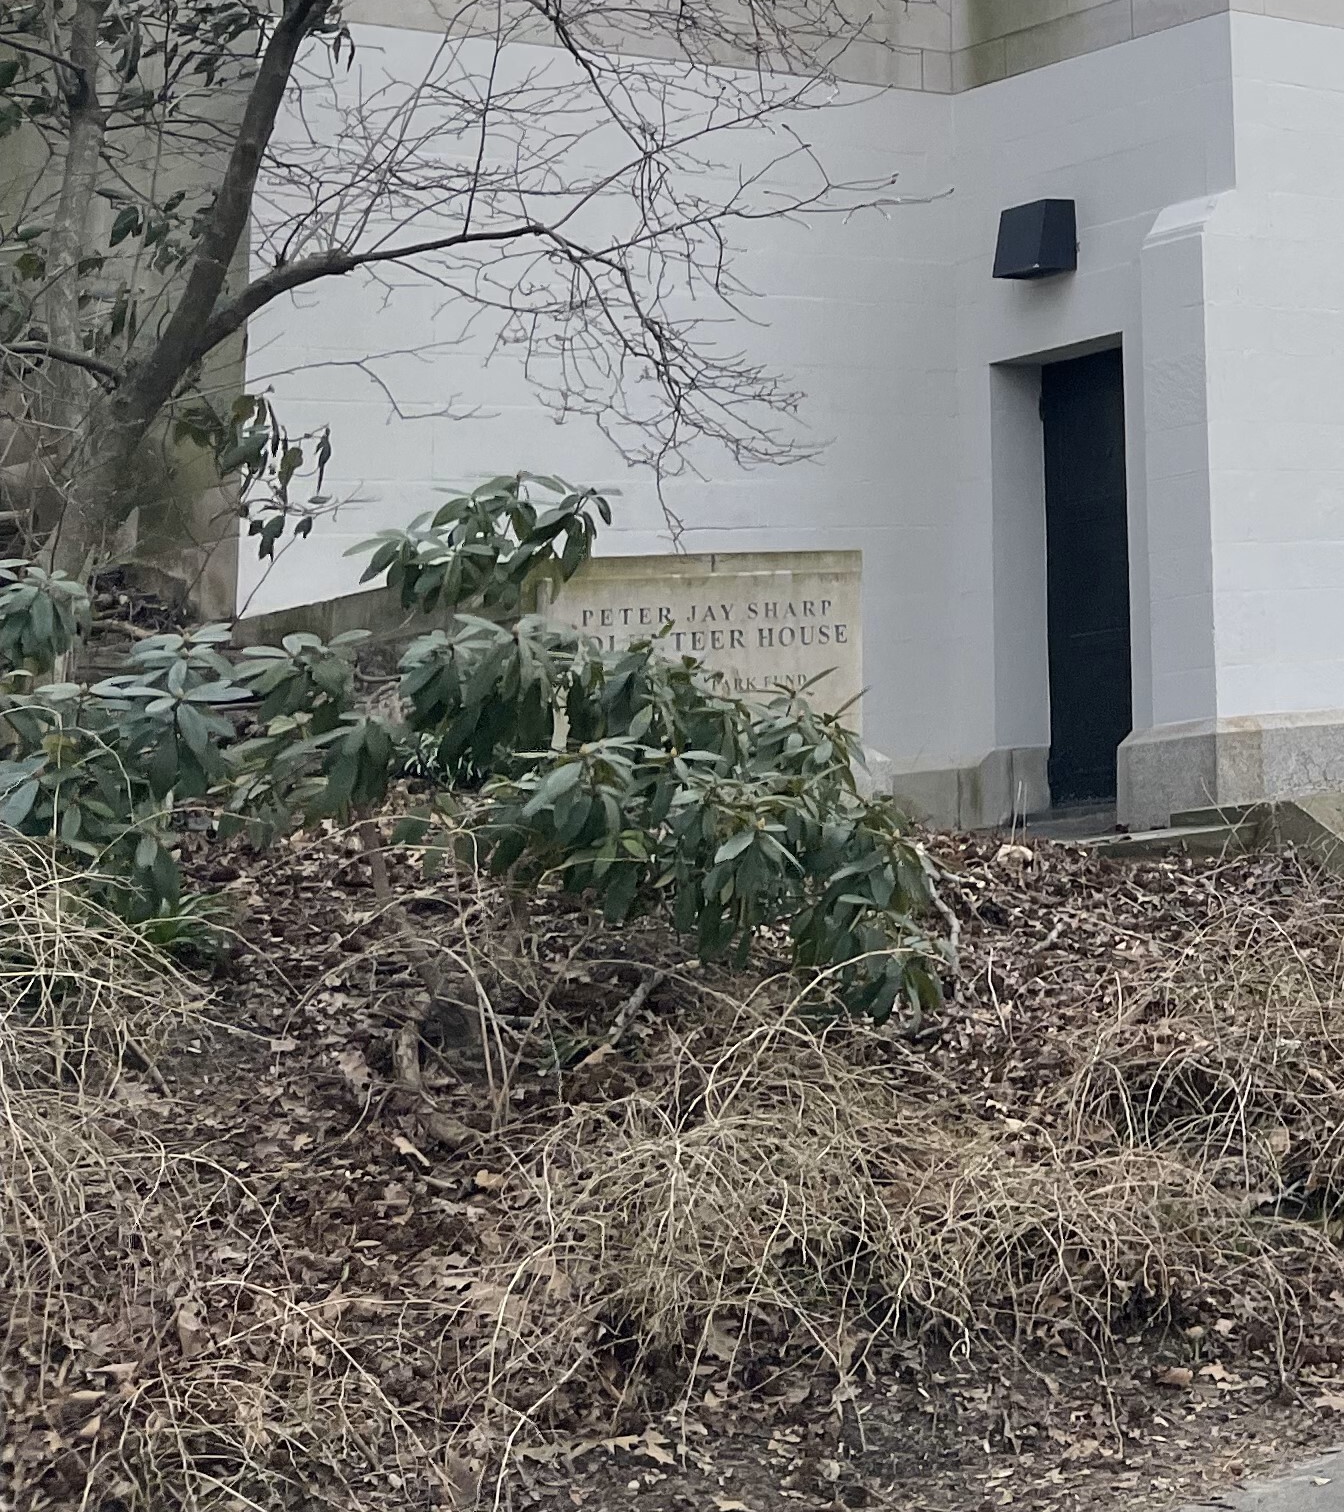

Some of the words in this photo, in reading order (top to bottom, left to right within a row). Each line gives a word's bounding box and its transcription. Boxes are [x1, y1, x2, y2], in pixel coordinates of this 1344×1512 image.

[581, 606, 672, 627] PETER
[686, 603, 734, 623] JAY
[747, 600, 833, 620] SHARP
[757, 624, 848, 648] HOUSE
